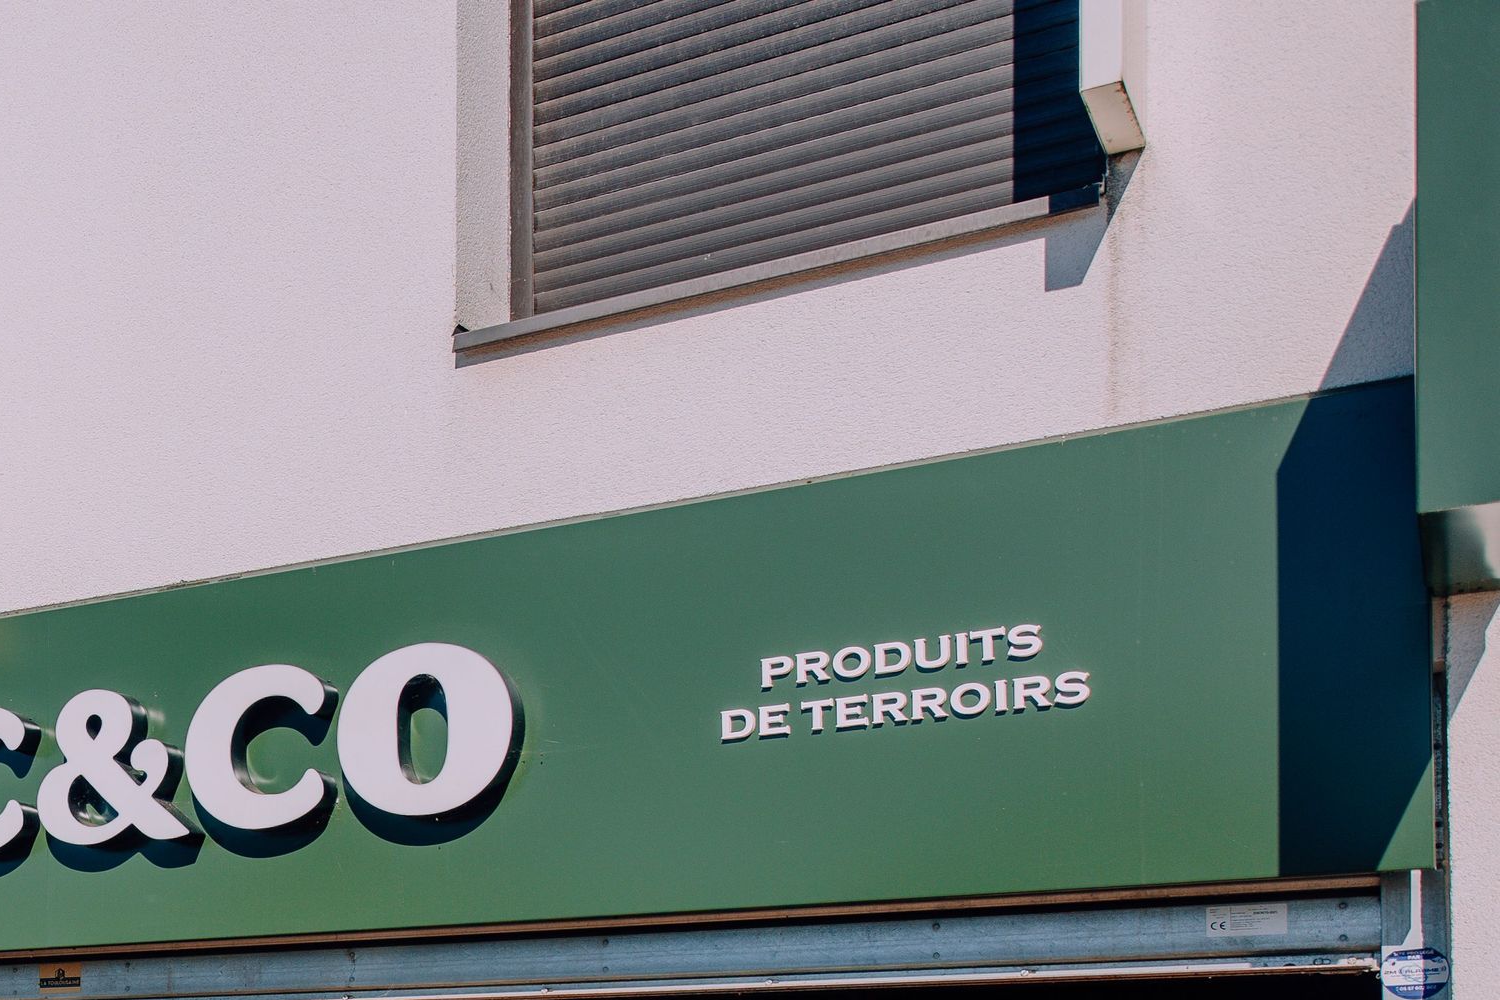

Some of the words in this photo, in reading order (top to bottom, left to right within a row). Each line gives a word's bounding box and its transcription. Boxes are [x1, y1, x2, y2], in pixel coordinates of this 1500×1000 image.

[759, 623, 1043, 690] PRODUITS
[720, 702, 792, 742] DE
[800, 670, 1092, 736] TERROIRS
